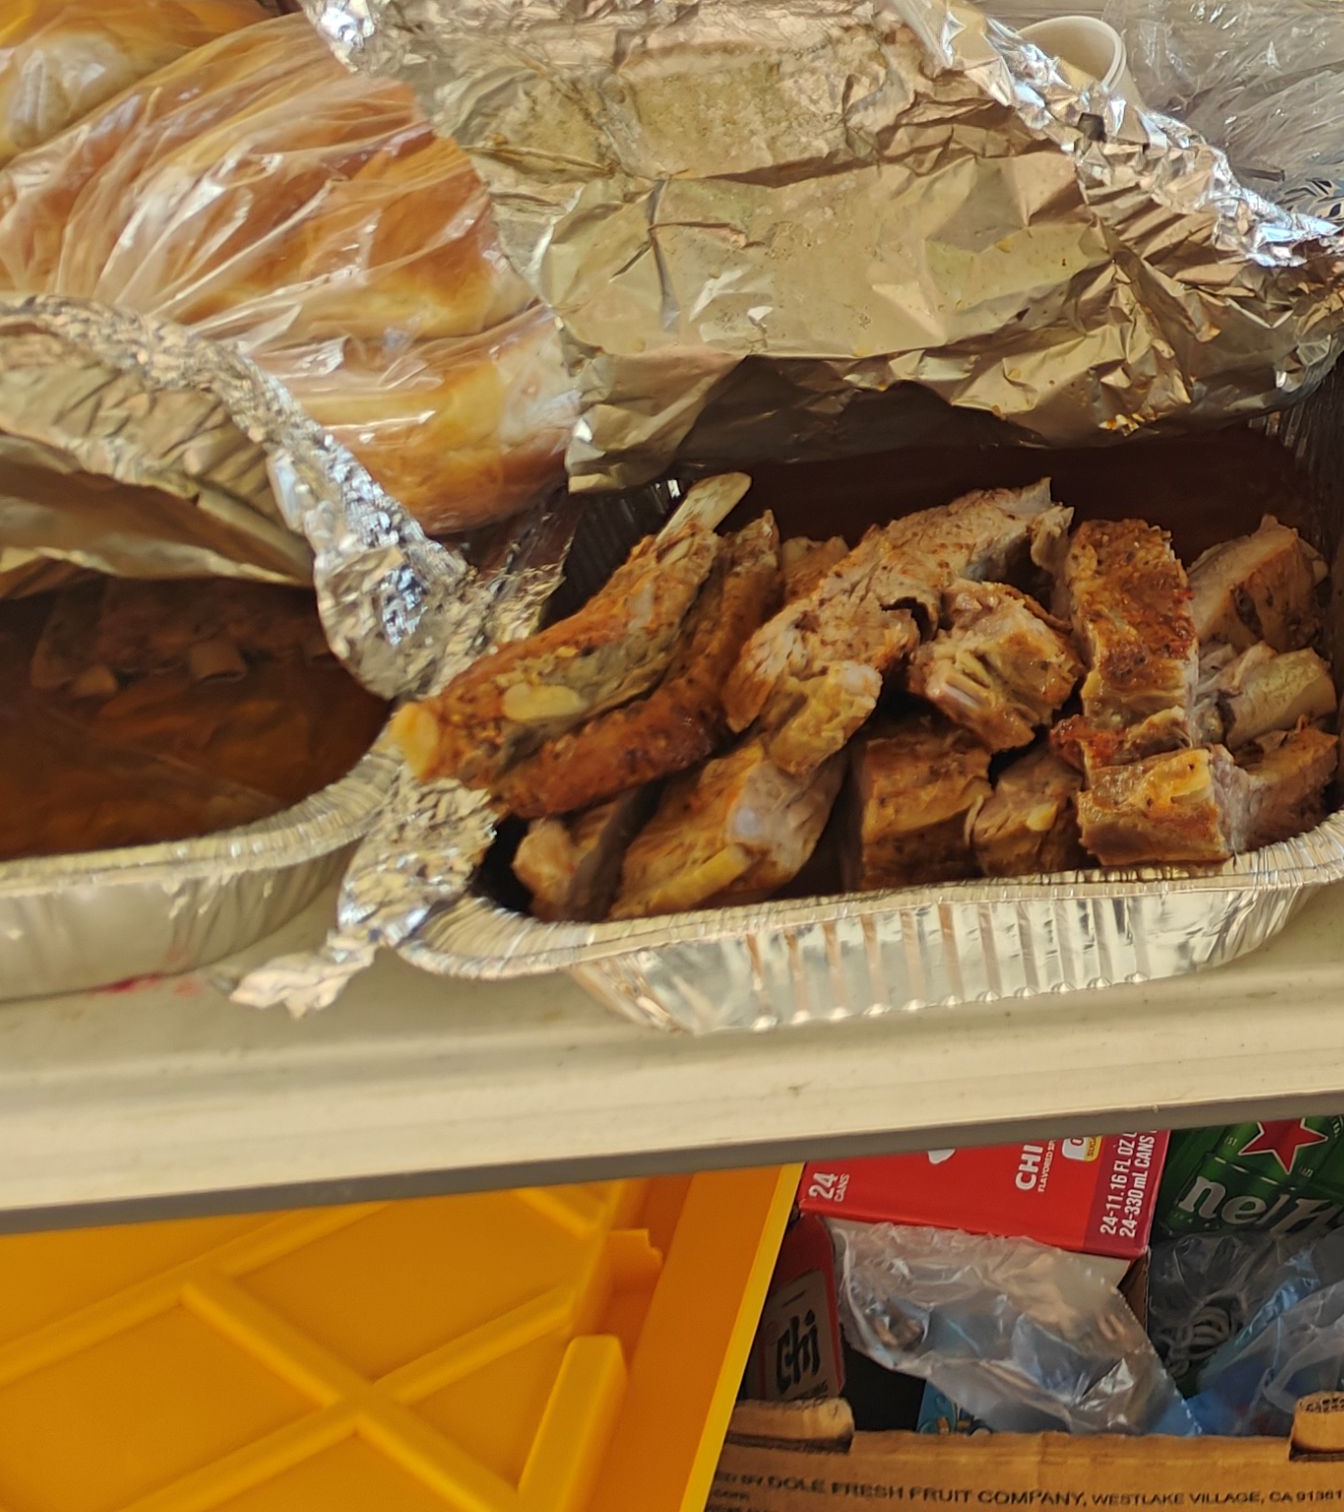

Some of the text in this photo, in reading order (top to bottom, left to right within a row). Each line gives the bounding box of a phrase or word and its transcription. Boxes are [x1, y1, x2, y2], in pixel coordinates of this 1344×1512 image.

[808, 1172, 838, 1199] 24
[1015, 1144, 1043, 1192] CHI
[1038, 1151, 1053, 1193] FLAVORED
[1099, 1139, 1135, 1236] 24-11.16 FL OZ
[1119, 1135, 1156, 1238] 24-330 mL CANS
[768, 1476, 825, 1492] DOLE
[831, 1481, 903, 1499] FRESH
[909, 1486, 972, 1503] FRUIT
[978, 1489, 1088, 1507] COMPANY,
[1092, 1490, 1185, 1506] WESTLAKE
[1188, 1490, 1264, 1505] VILLAGE,
[1269, 1489, 1293, 1502] CA
